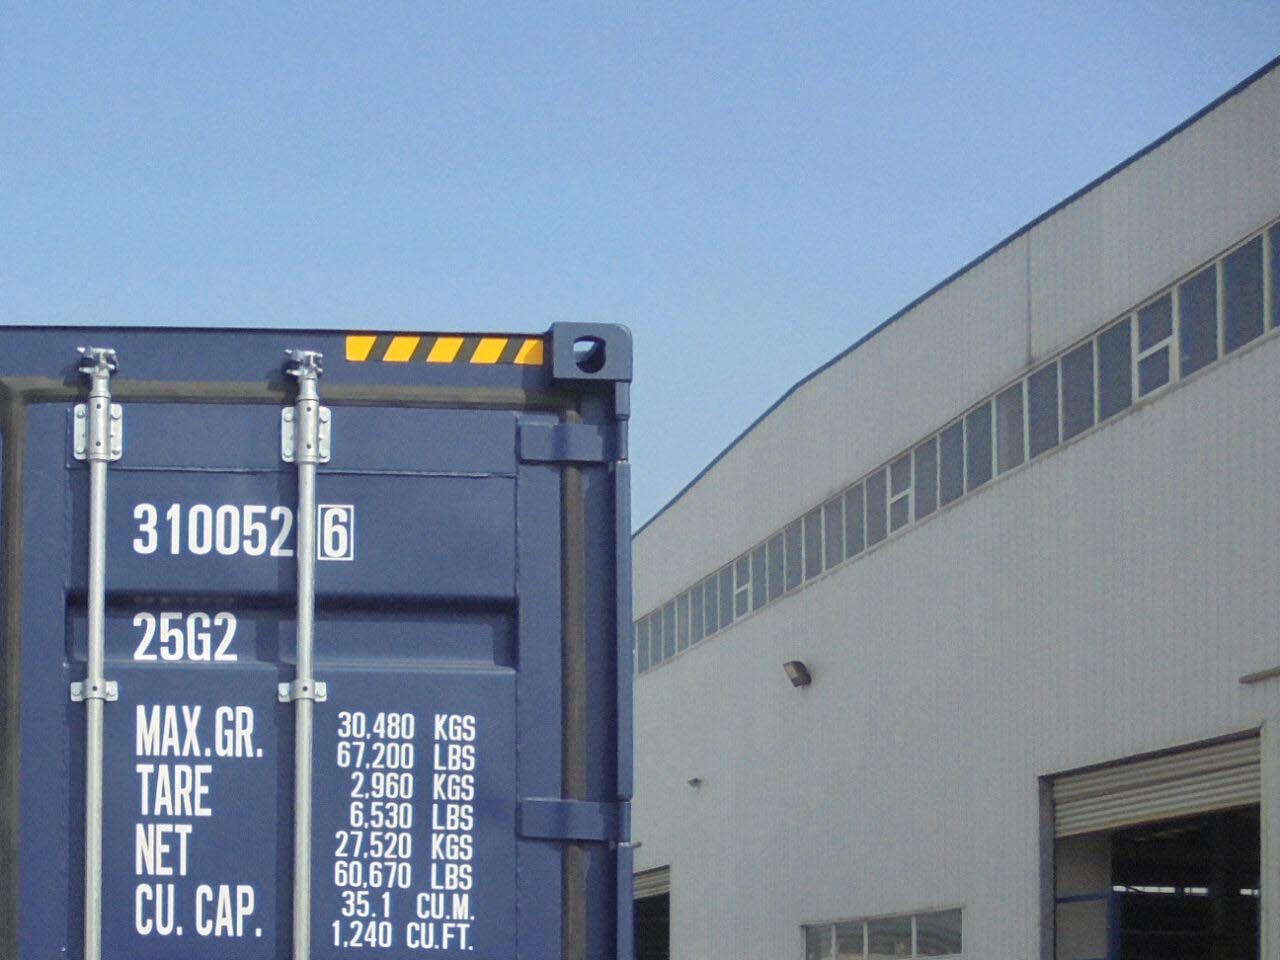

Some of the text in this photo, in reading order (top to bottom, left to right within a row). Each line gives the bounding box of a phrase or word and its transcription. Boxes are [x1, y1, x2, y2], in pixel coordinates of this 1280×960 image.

[133, 503, 350, 558] 310052 6
[133, 612, 238, 662] 25G2
[337, 711, 476, 742] 30,480 KGS
[337, 741, 475, 771] 67,200 LBS
[136, 764, 213, 817] TARE
[350, 771, 475, 801] 2,960 KGS
[350, 802, 474, 831] 6,530 LBS
[135, 823, 193, 876] NET
[334, 830, 473, 861] 27,520 KGS
[334, 860, 473, 891] 60,670 LBS
[135, 883, 262, 937] CU. CAP.
[341, 890, 475, 921] 35.1 CU.M.
[332, 920, 473, 950] 1,240 CU.FT.
